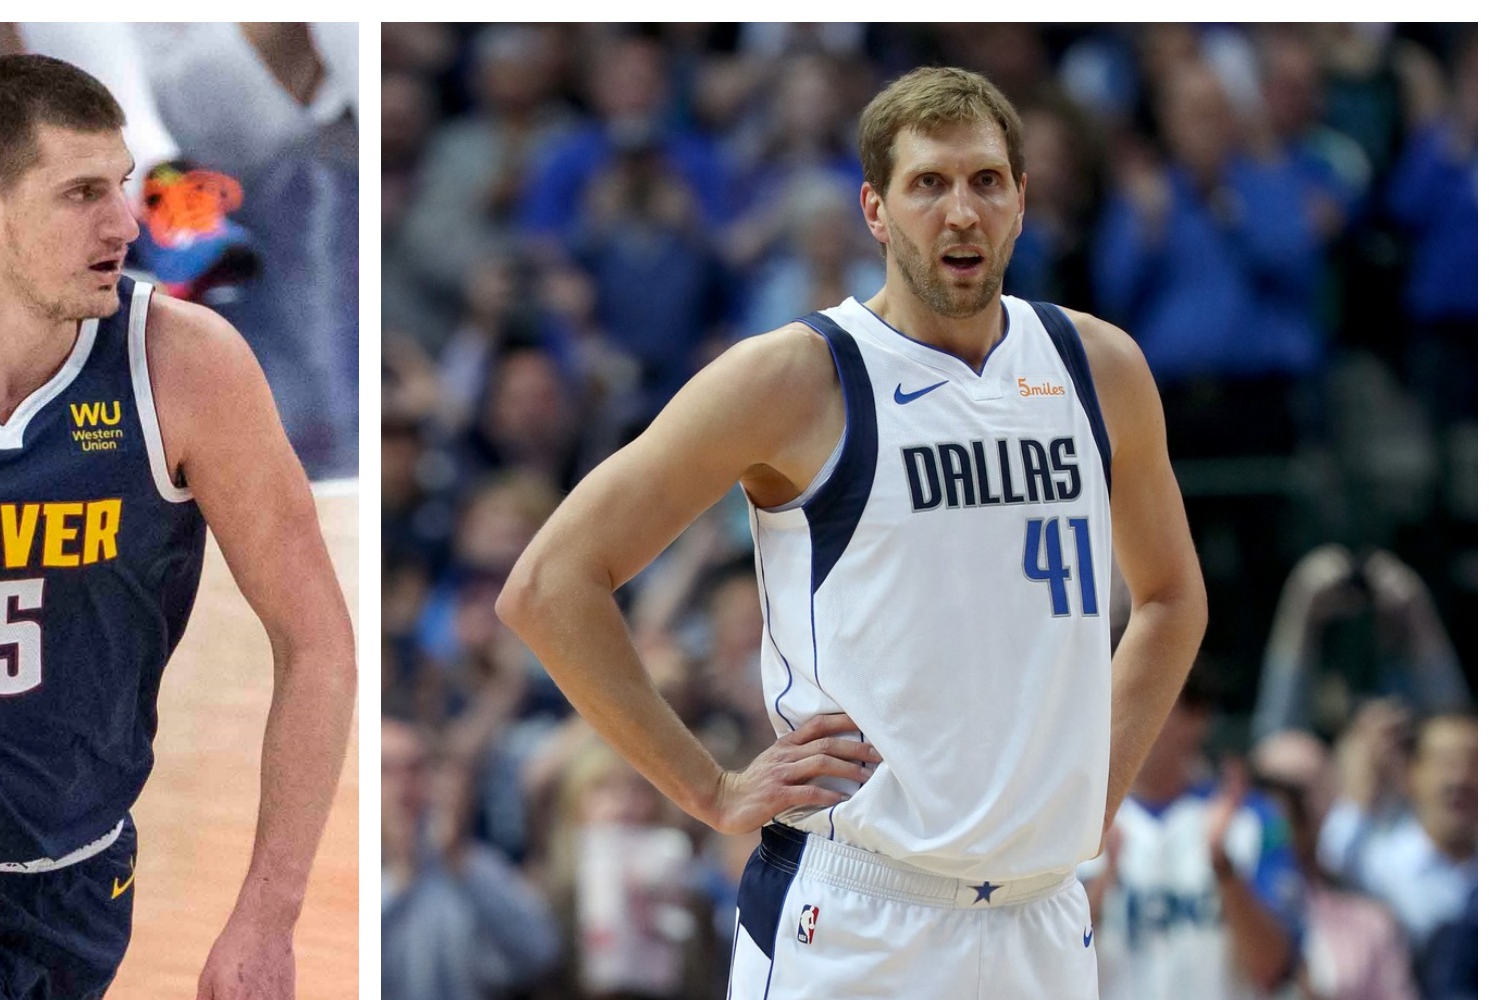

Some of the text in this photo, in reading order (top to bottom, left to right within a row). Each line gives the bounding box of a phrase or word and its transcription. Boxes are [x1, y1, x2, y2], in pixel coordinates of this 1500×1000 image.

[1017, 377, 1066, 397] 5miles
[69, 400, 121, 427] WU
[72, 429, 123, 441] Western
[82, 439, 117, 451] Union
[900, 437, 1082, 514] DALLAS
[1021, 515, 1100, 618] 41
